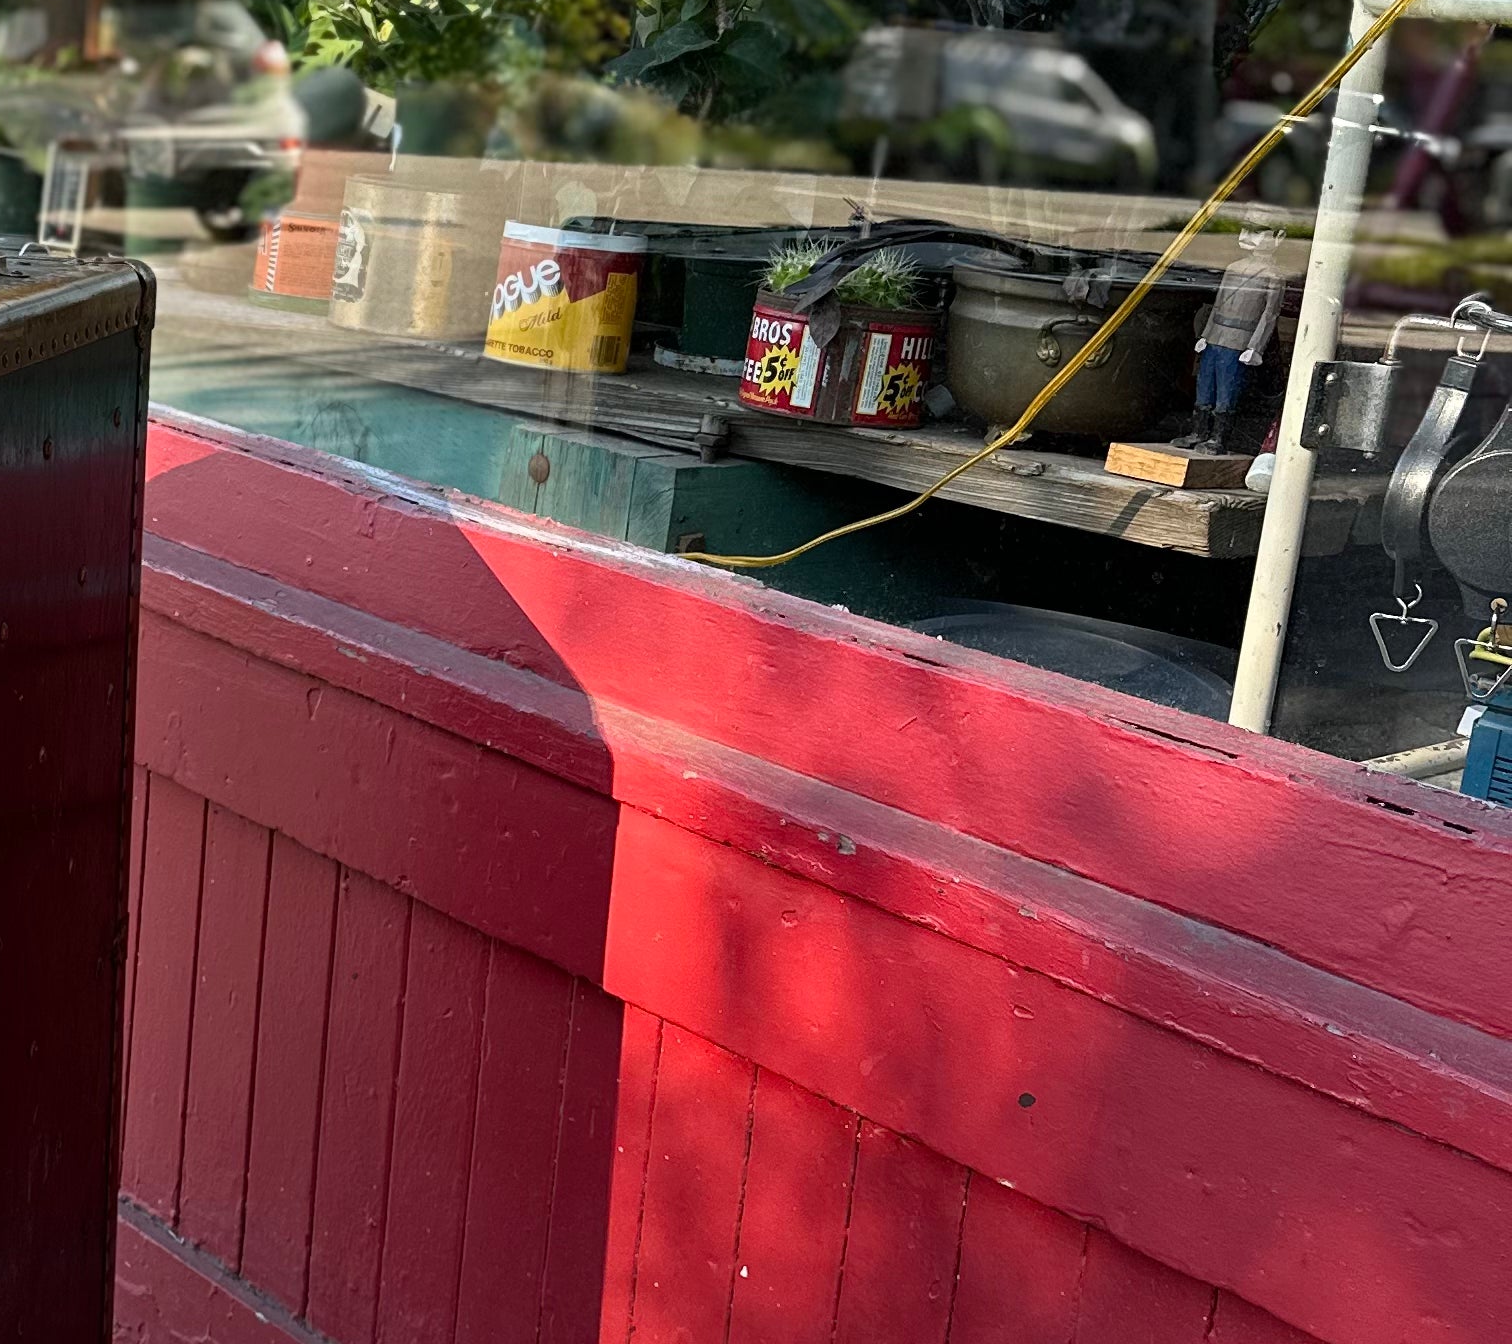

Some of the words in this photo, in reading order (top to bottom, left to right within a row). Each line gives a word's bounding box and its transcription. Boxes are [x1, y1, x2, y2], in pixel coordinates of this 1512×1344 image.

[752, 317, 793, 345] BROS
[508, 343, 554, 359] TOBACCO
[778, 368, 796, 381] OFF
